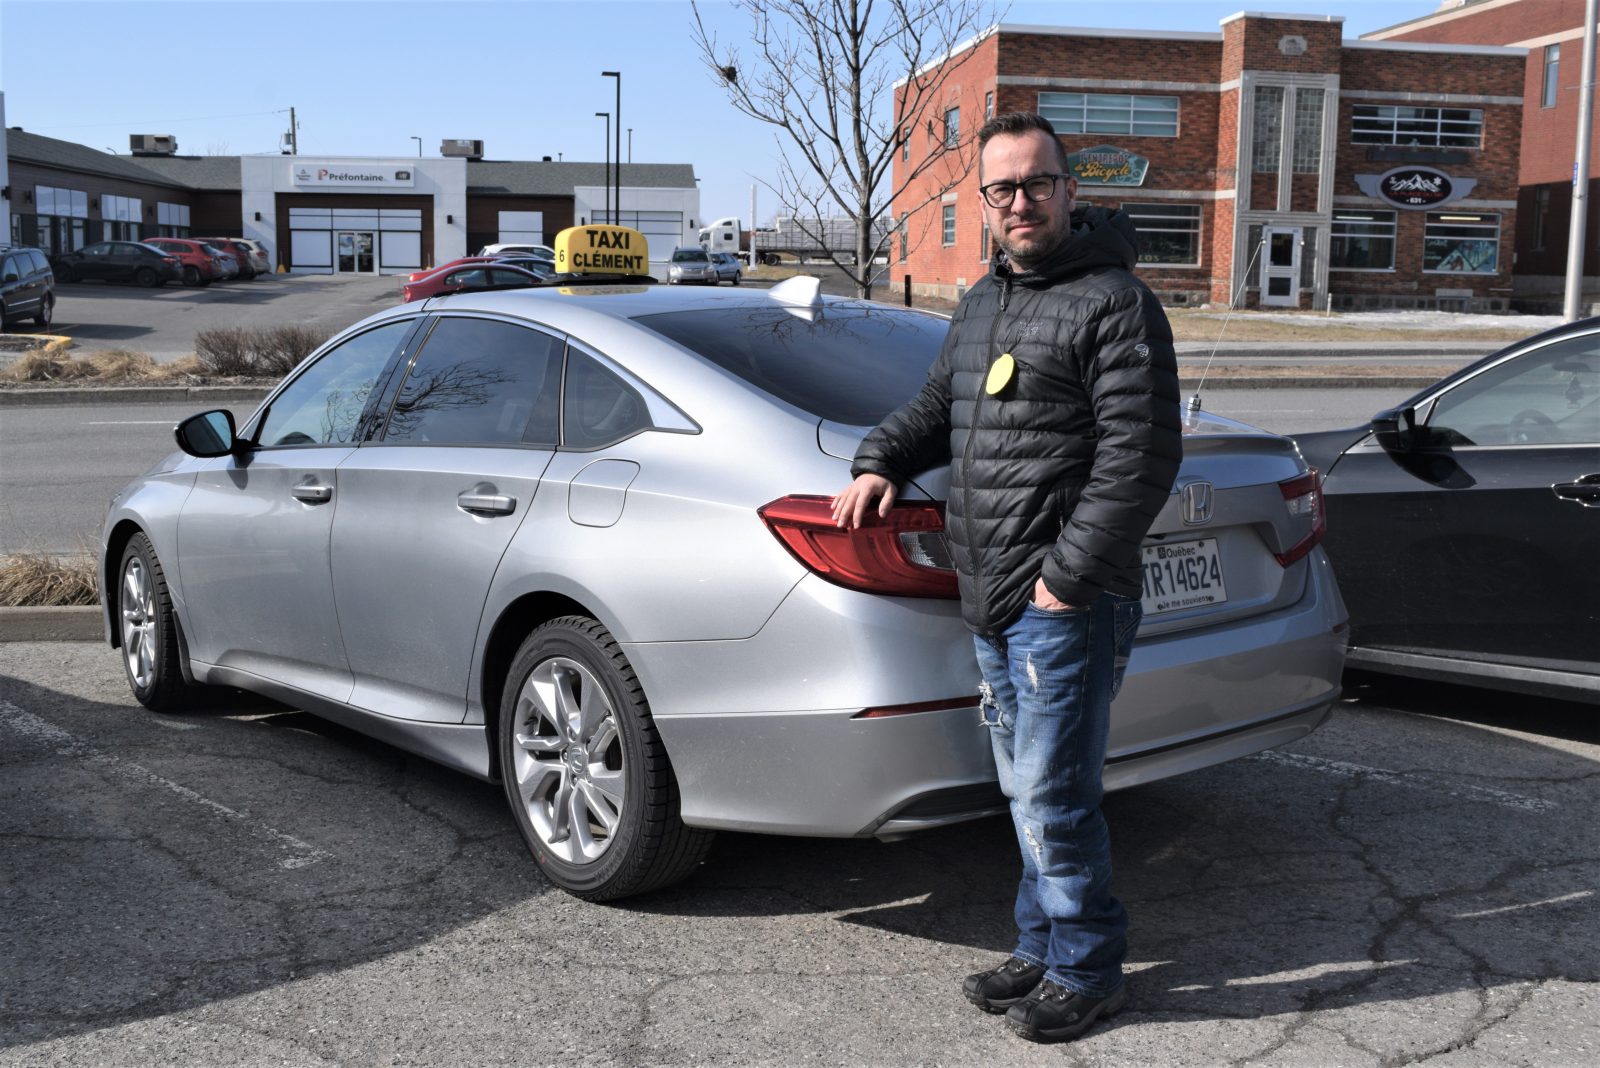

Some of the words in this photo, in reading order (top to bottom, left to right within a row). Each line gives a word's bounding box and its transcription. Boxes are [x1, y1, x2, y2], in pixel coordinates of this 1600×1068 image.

[329, 172, 384, 181] Préfontaine
[586, 229, 630, 250] TAXI
[559, 249, 565, 262] 6
[573, 250, 643, 270] CLÉMENT
[1166, 546, 1196, 558] Québec
[1141, 553, 1222, 598] TR14624
